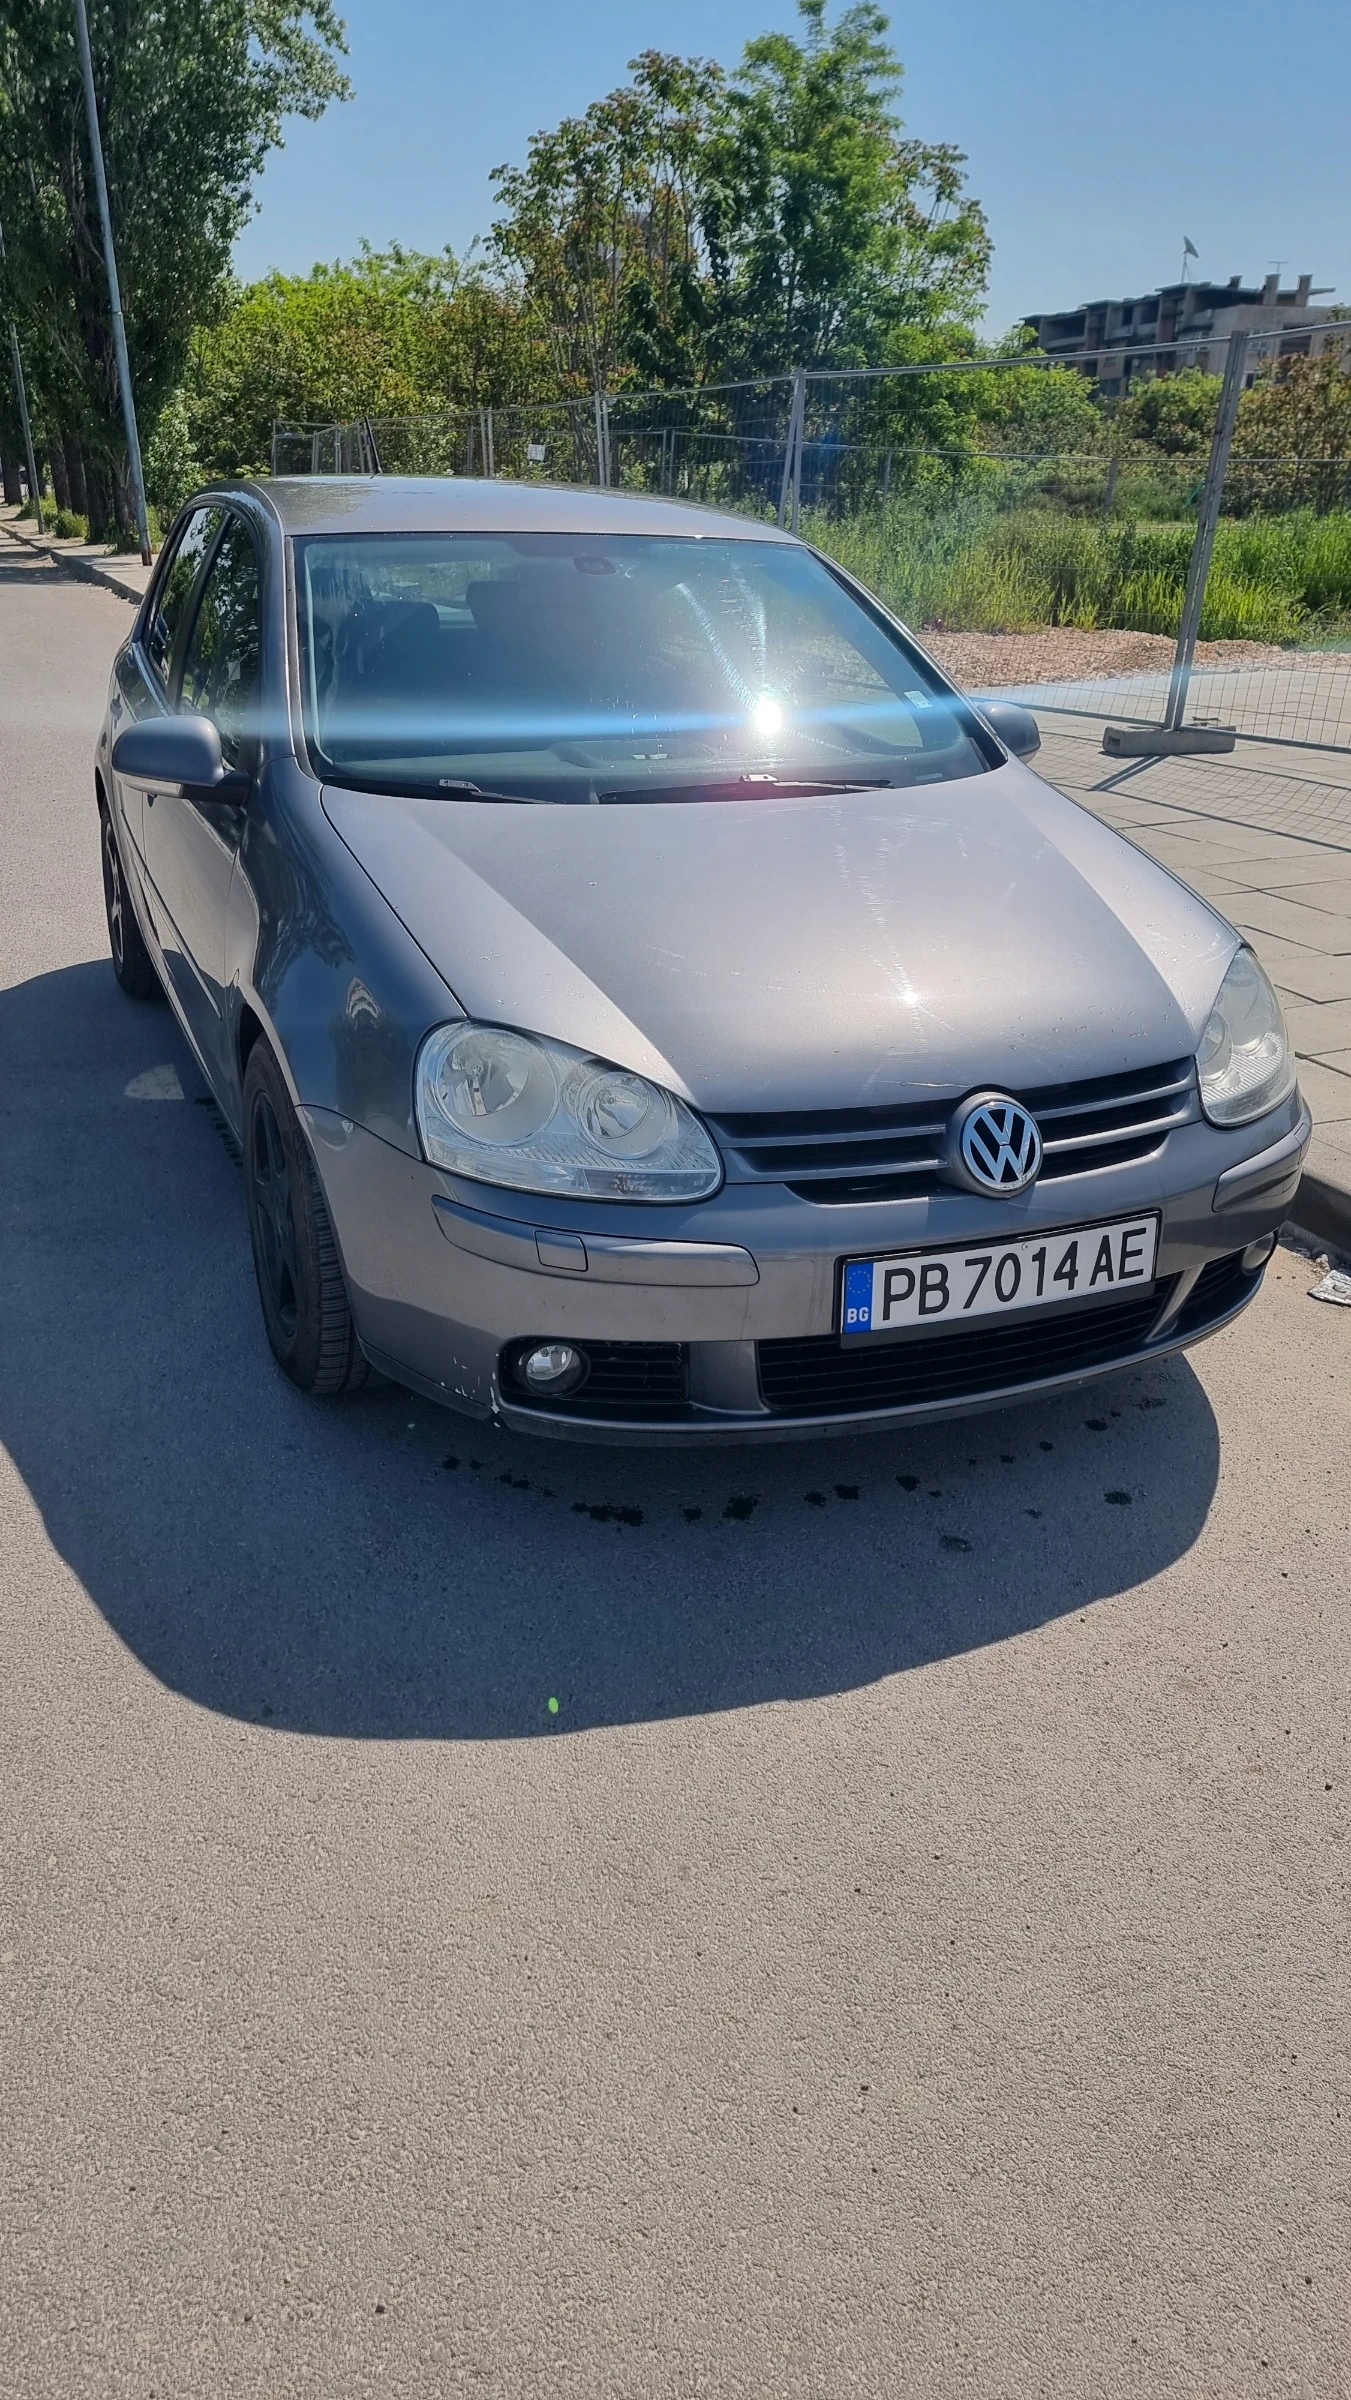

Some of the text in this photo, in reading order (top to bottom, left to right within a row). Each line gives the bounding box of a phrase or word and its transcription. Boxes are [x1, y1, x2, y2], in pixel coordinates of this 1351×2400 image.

[962, 1103, 1039, 1190] VW
[847, 1307, 869, 1323] BG
[882, 1228, 1147, 1320] PB 7014 AE
